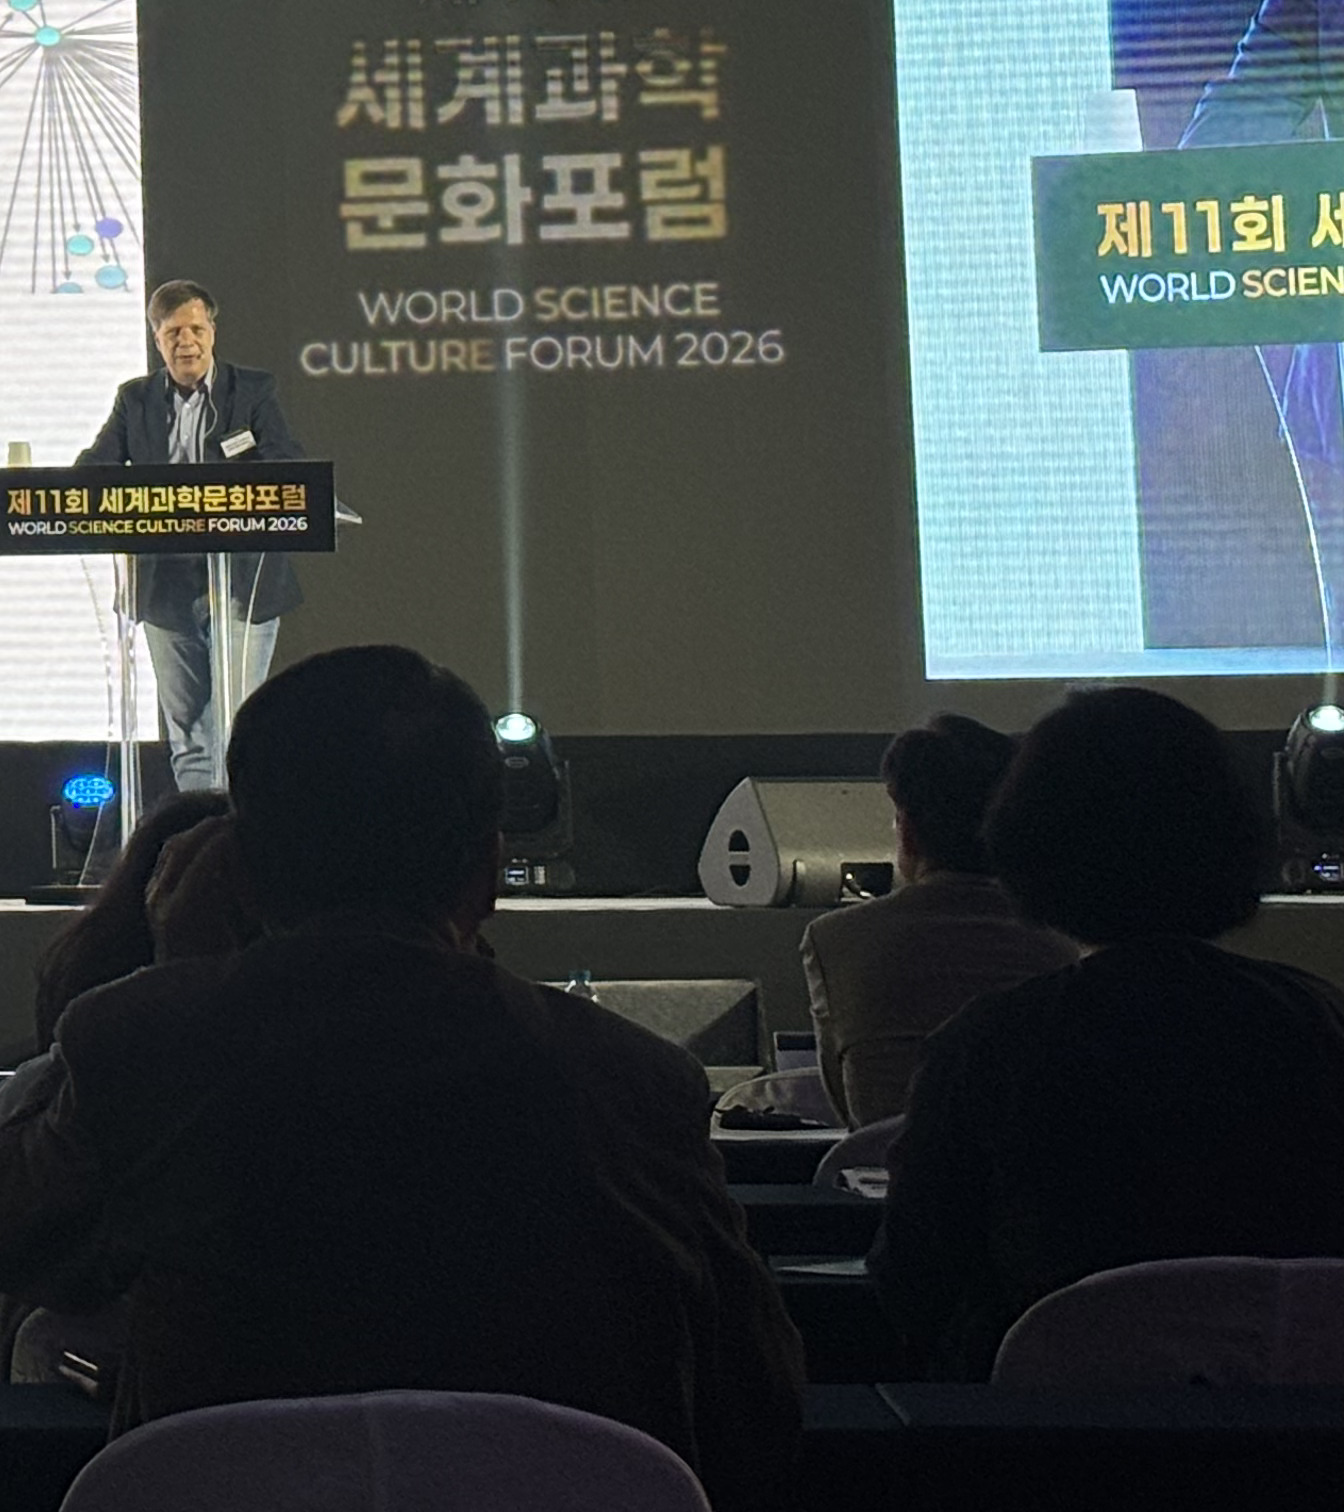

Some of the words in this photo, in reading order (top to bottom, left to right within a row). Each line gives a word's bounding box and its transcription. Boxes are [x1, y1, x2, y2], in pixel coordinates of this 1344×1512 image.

[336, 28, 727, 132] 세계과학
[339, 146, 727, 250] 문화포럼
[1096, 193, 1286, 258] 제11회
[358, 287, 526, 326] WORLD
[533, 281, 722, 323] SCIENCE
[1099, 270, 1237, 304] WORLD
[298, 338, 498, 378] CULTURE
[504, 334, 665, 372] FORUM
[674, 328, 786, 368] 2026
[7, 487, 89, 516] 제11회
[98, 484, 306, 514] 세계과학문화포럼
[7, 520, 67, 536] WORLD
[68, 519, 134, 534] SCIENCE
[135, 518, 205, 534] CULTURE
[208, 517, 266, 533] FORUM
[267, 516, 308, 532] 2026
